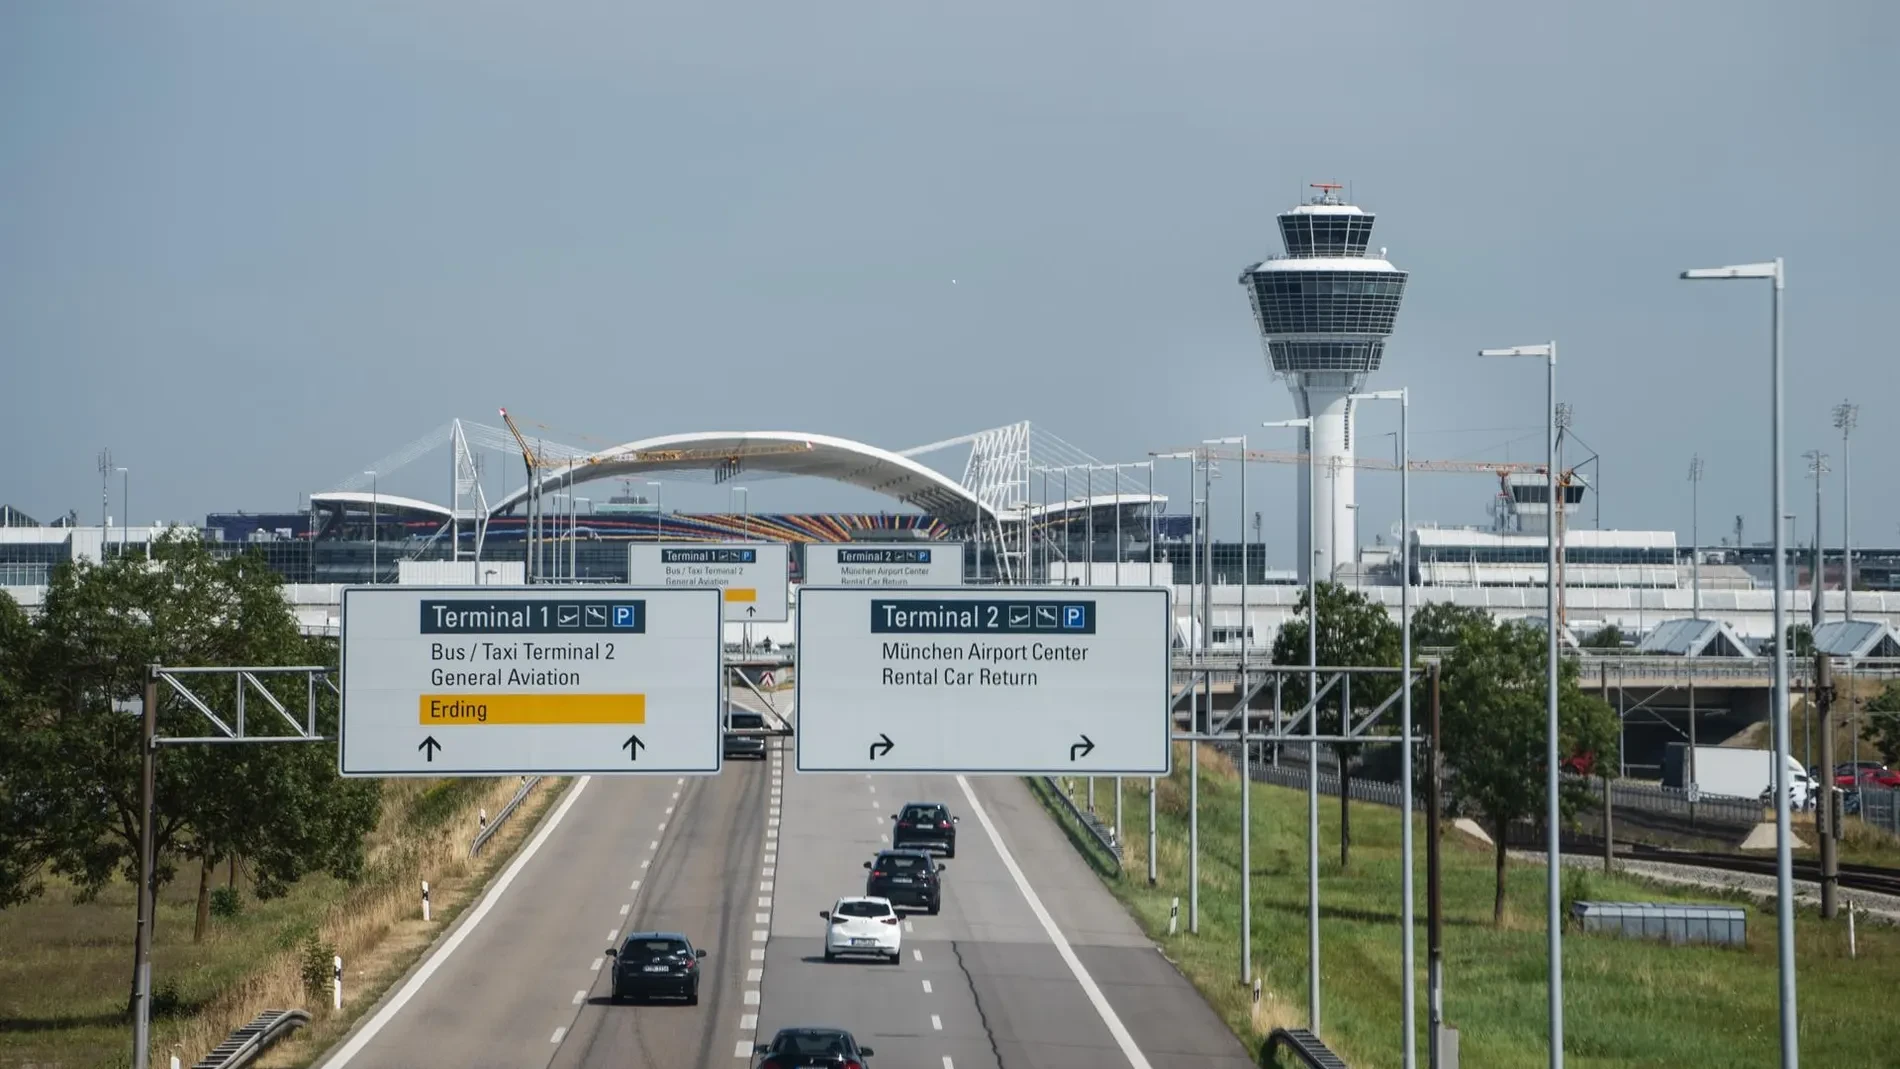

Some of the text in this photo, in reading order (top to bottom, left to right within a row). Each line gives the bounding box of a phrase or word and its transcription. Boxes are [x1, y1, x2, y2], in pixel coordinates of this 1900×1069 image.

[666, 550, 716, 561] Terminal 1
[841, 551, 892, 561] Terminal 2
[666, 566, 681, 575] Bus
[688, 566, 703, 575] Taxi
[705, 566, 737, 575] Terminal
[841, 566, 929, 576] München Airport Center
[666, 577, 729, 585] General Aviation
[841, 577, 908, 585] Rental Car Return
[432, 605, 548, 628] Terminal 1
[617, 608, 630, 624] P
[882, 605, 1000, 628] Terminal 2
[1068, 608, 1080, 624] P
[431, 643, 615, 661] Bus / Taxi Terminal 2
[882, 642, 1089, 665] München Airport Center
[431, 669, 580, 686] General Aviation
[882, 668, 1038, 686] Rental Car Return
[430, 701, 488, 721] Erding
